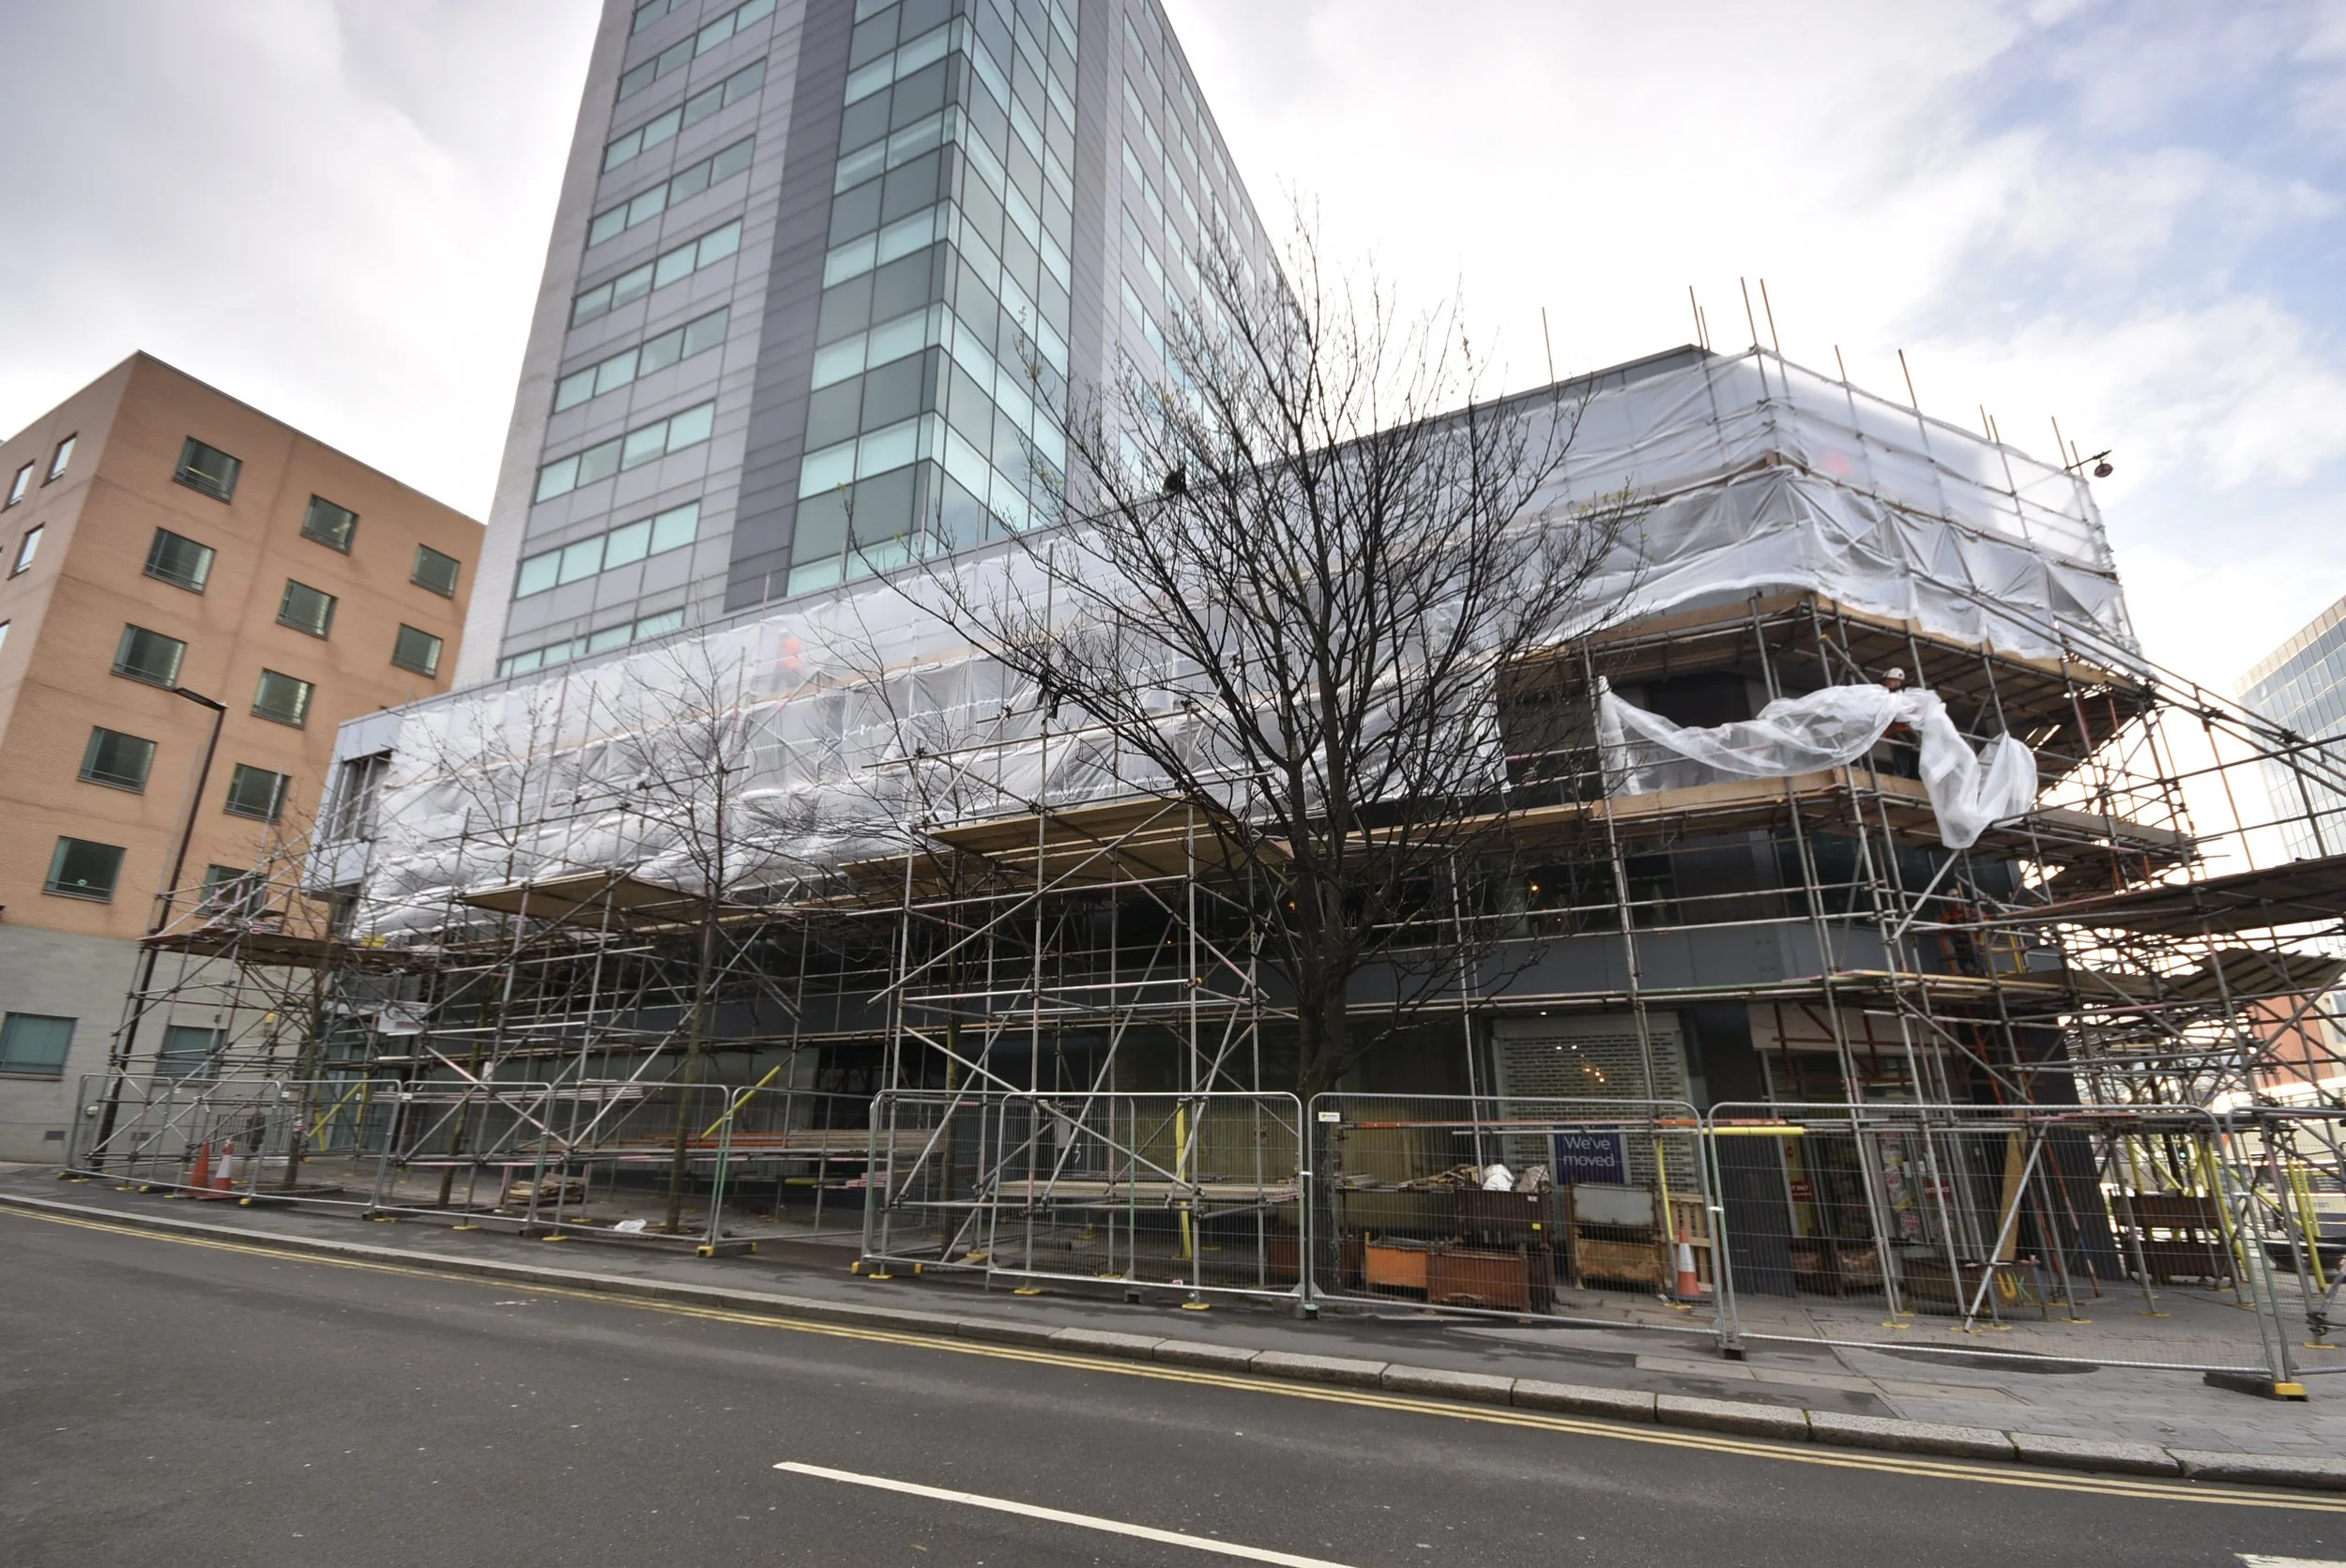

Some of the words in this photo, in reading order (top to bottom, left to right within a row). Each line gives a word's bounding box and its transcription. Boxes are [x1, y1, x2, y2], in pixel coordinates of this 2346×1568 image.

[1563, 1136, 1611, 1149] We've
[1563, 1153, 1615, 1166] moved
[1996, 1271, 2034, 1301] UK
